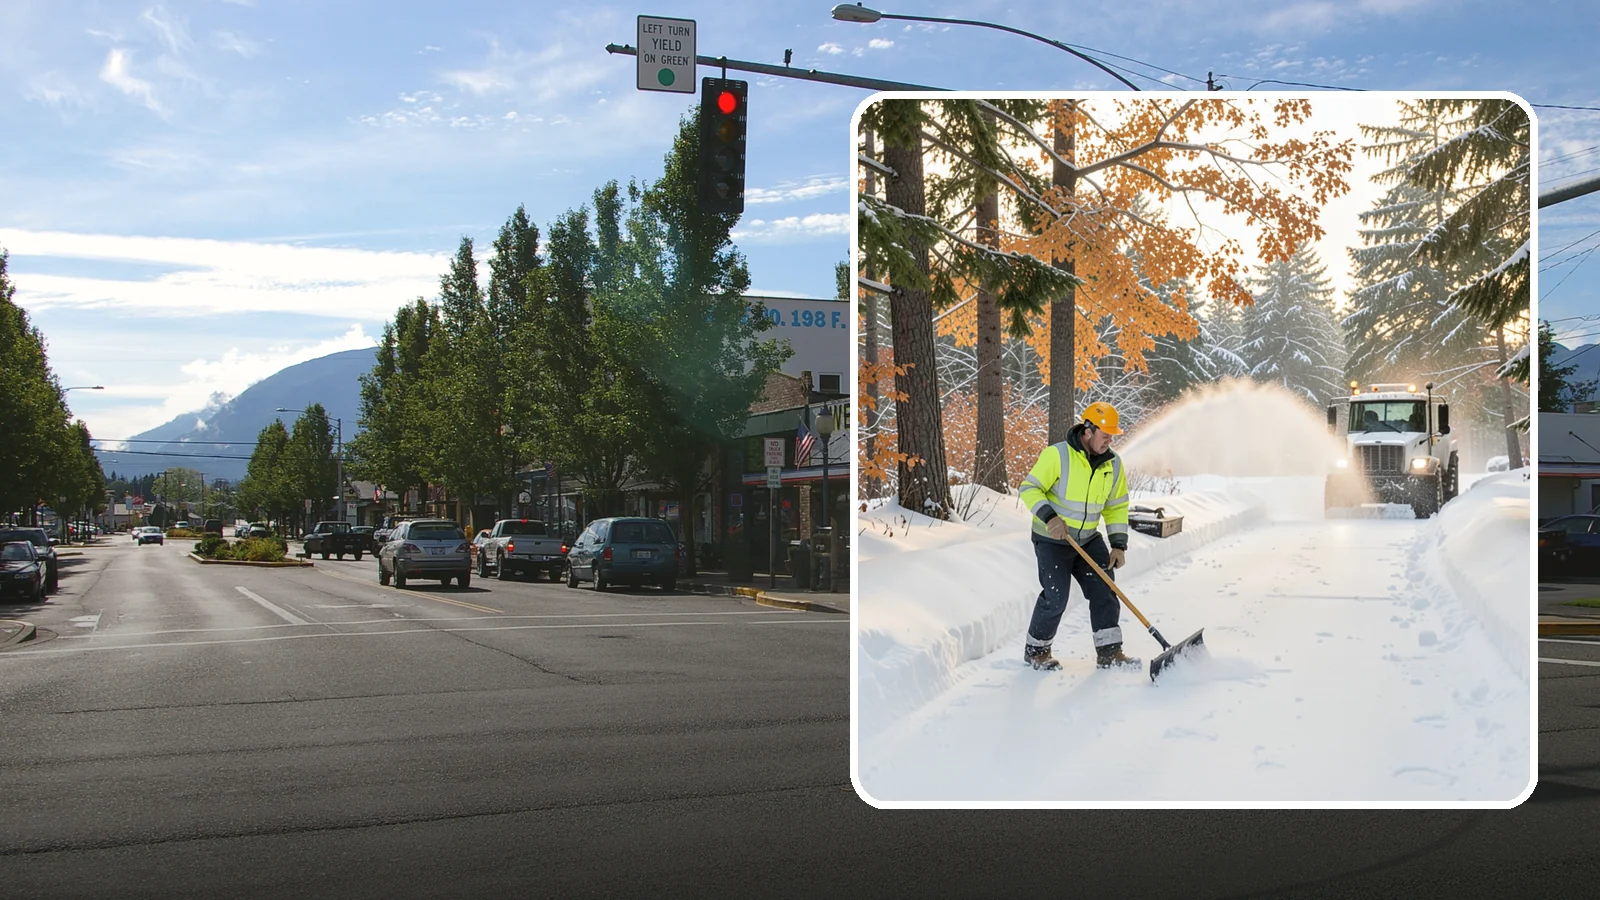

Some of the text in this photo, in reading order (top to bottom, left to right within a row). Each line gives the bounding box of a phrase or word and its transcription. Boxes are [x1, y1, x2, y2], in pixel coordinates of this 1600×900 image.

[643, 24, 690, 37] LEFT TURN
[652, 38, 682, 52] YIELD
[644, 53, 689, 66] ON GREEN
[791, 309, 826, 328] 198
[831, 311, 847, 329] F.
